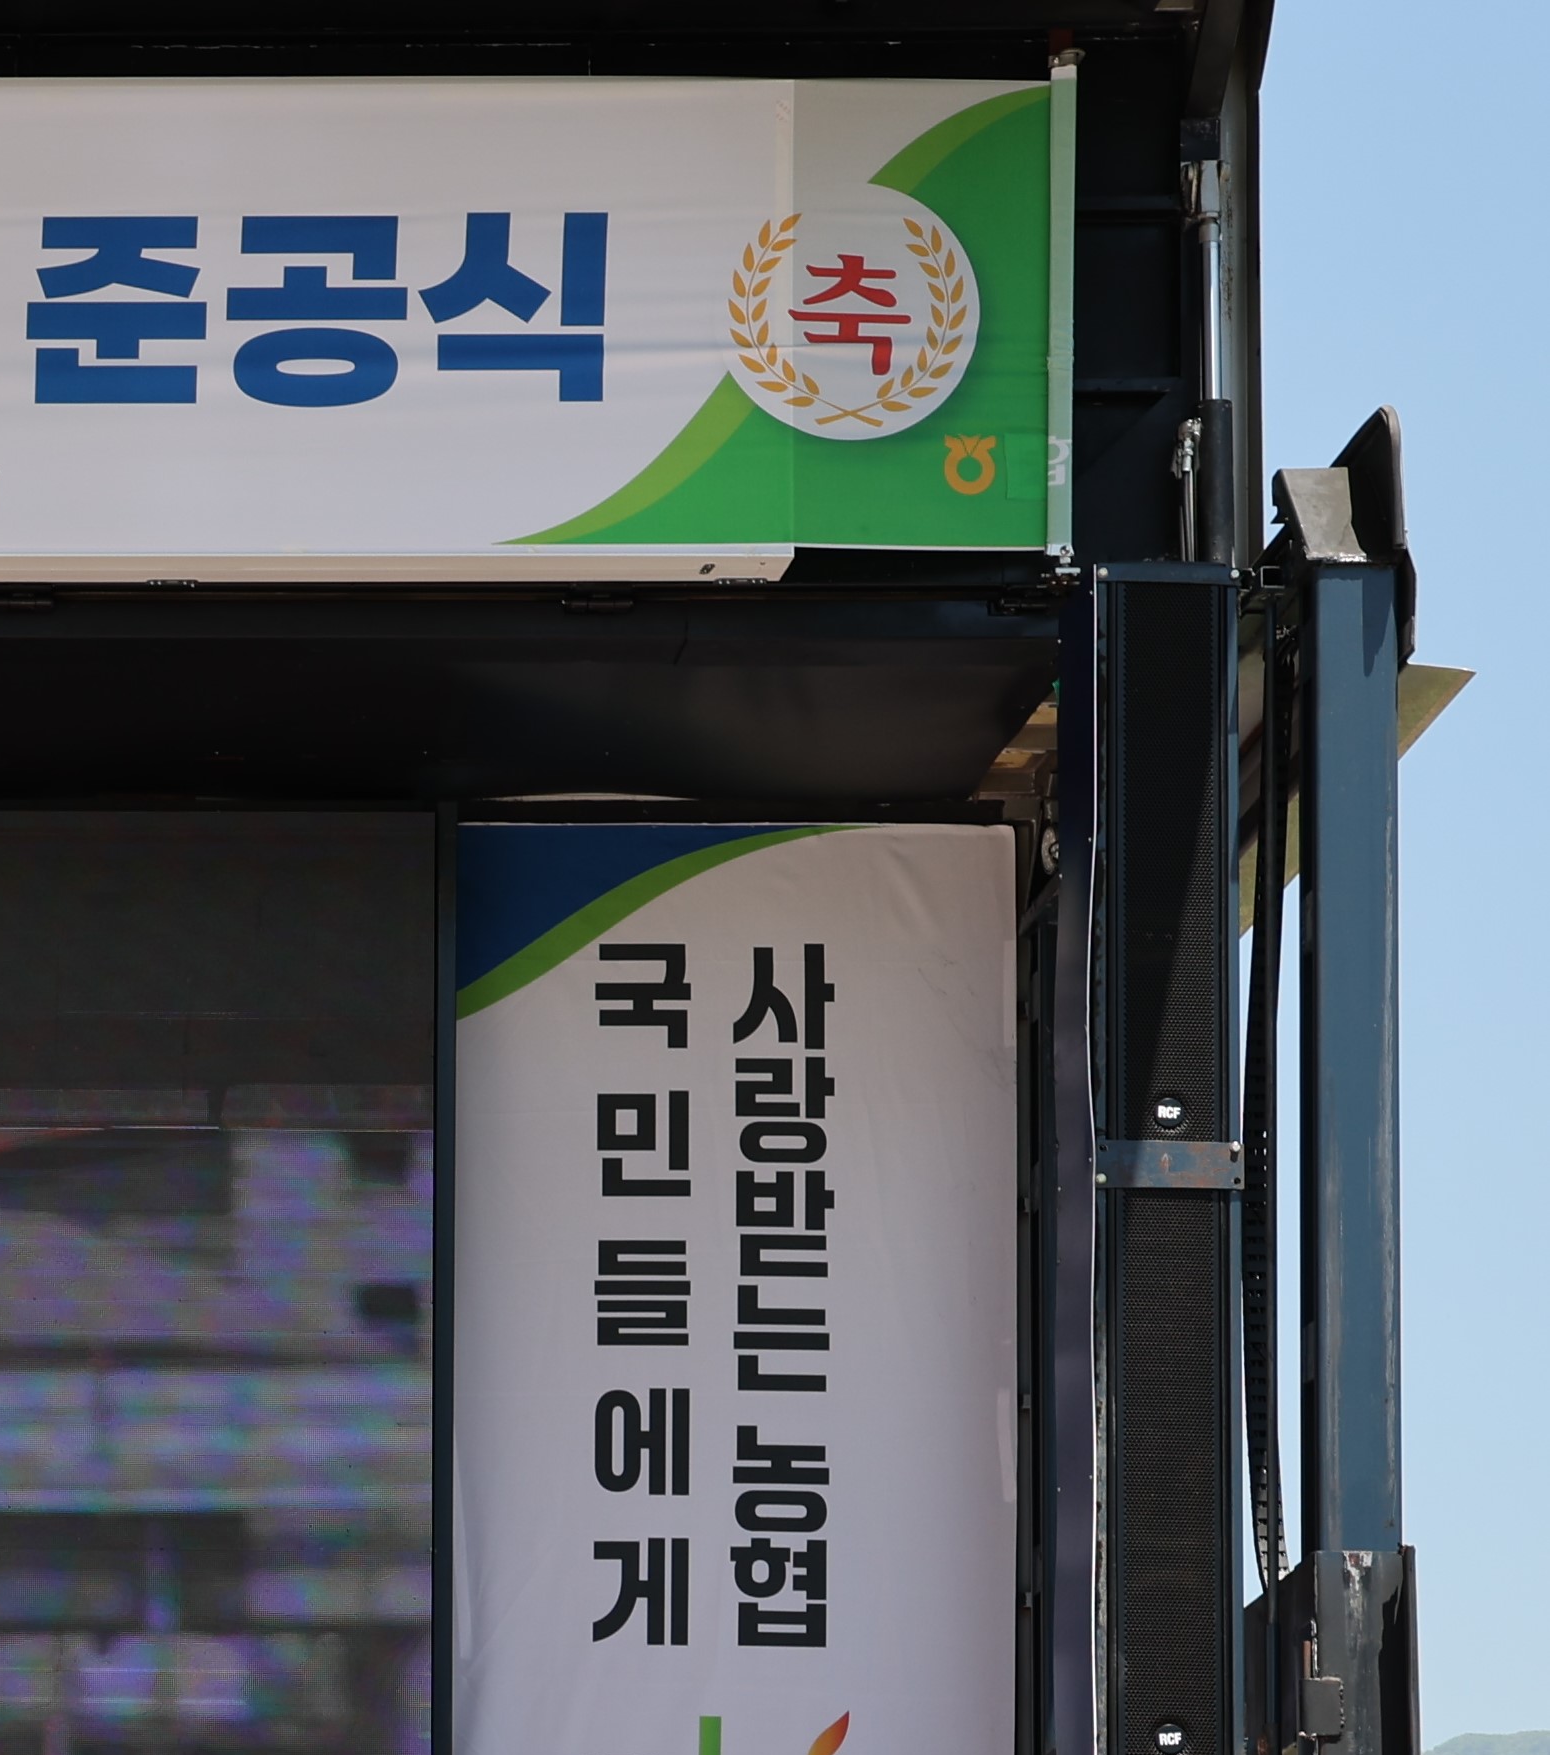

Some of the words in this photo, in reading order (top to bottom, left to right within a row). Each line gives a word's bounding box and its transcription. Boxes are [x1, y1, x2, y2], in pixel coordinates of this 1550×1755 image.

[25, 212, 609, 408] 준공식
[789, 254, 911, 376] 축
[1157, 1105, 1181, 1119] RCF
[593, 943, 691, 1646] 국민들에게
[1159, 1732, 1182, 1746] RCF
